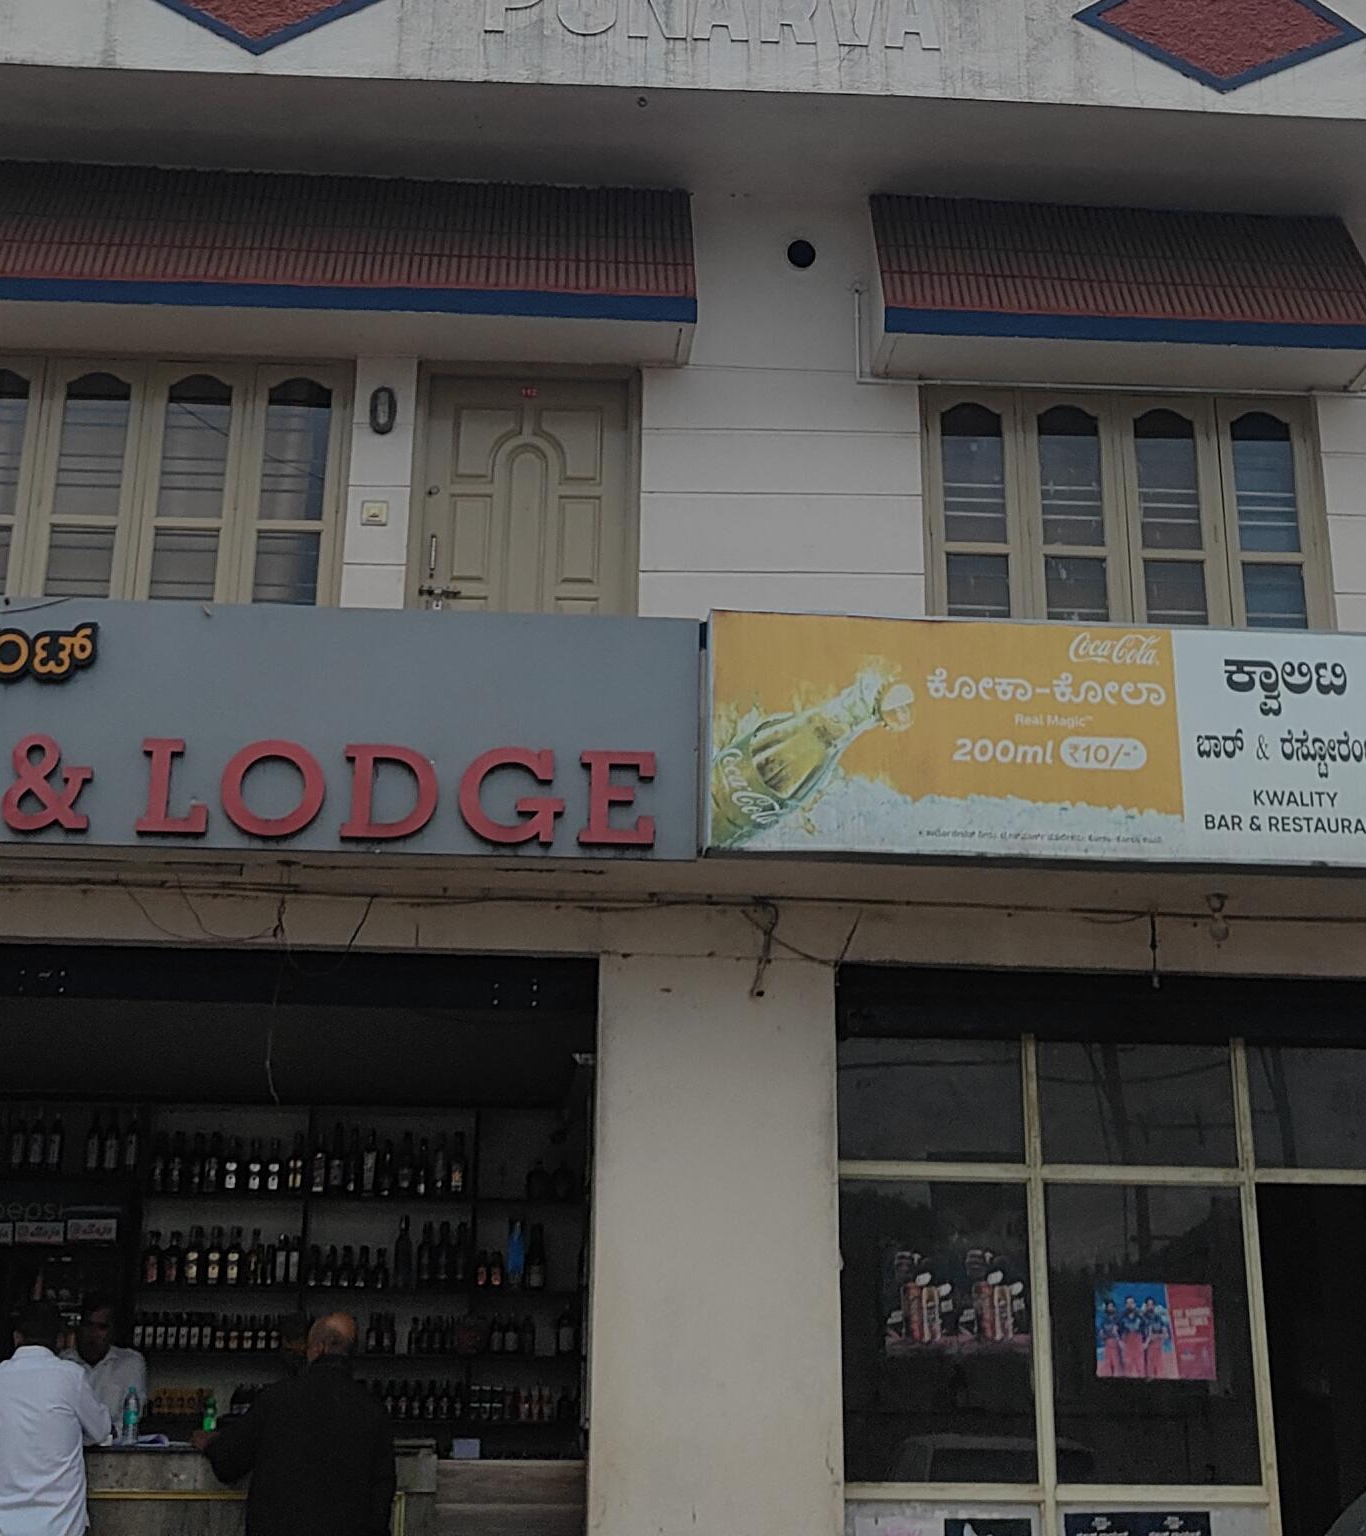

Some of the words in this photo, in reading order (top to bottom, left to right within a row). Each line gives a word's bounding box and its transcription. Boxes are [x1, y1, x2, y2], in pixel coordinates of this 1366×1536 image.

[1069, 632, 1162, 665] Coca-Cola
[926, 666, 1167, 706] ಕೋಕಾ-ಕೋಲಾ
[1223, 658, 1348, 717] ಕ್ವಾಲಿಟಿ
[1014, 712, 1044, 726] Real
[952, 737, 1054, 765] 200ml
[1196, 728, 1244, 759] ಬಾರ್
[1255, 733, 1271, 761] &
[1, 734, 94, 832] &
[135, 737, 658, 846] LODGE
[1252, 789, 1338, 808] KWALITY
[1204, 813, 1243, 832] BAR
[1249, 814, 1262, 833] &
